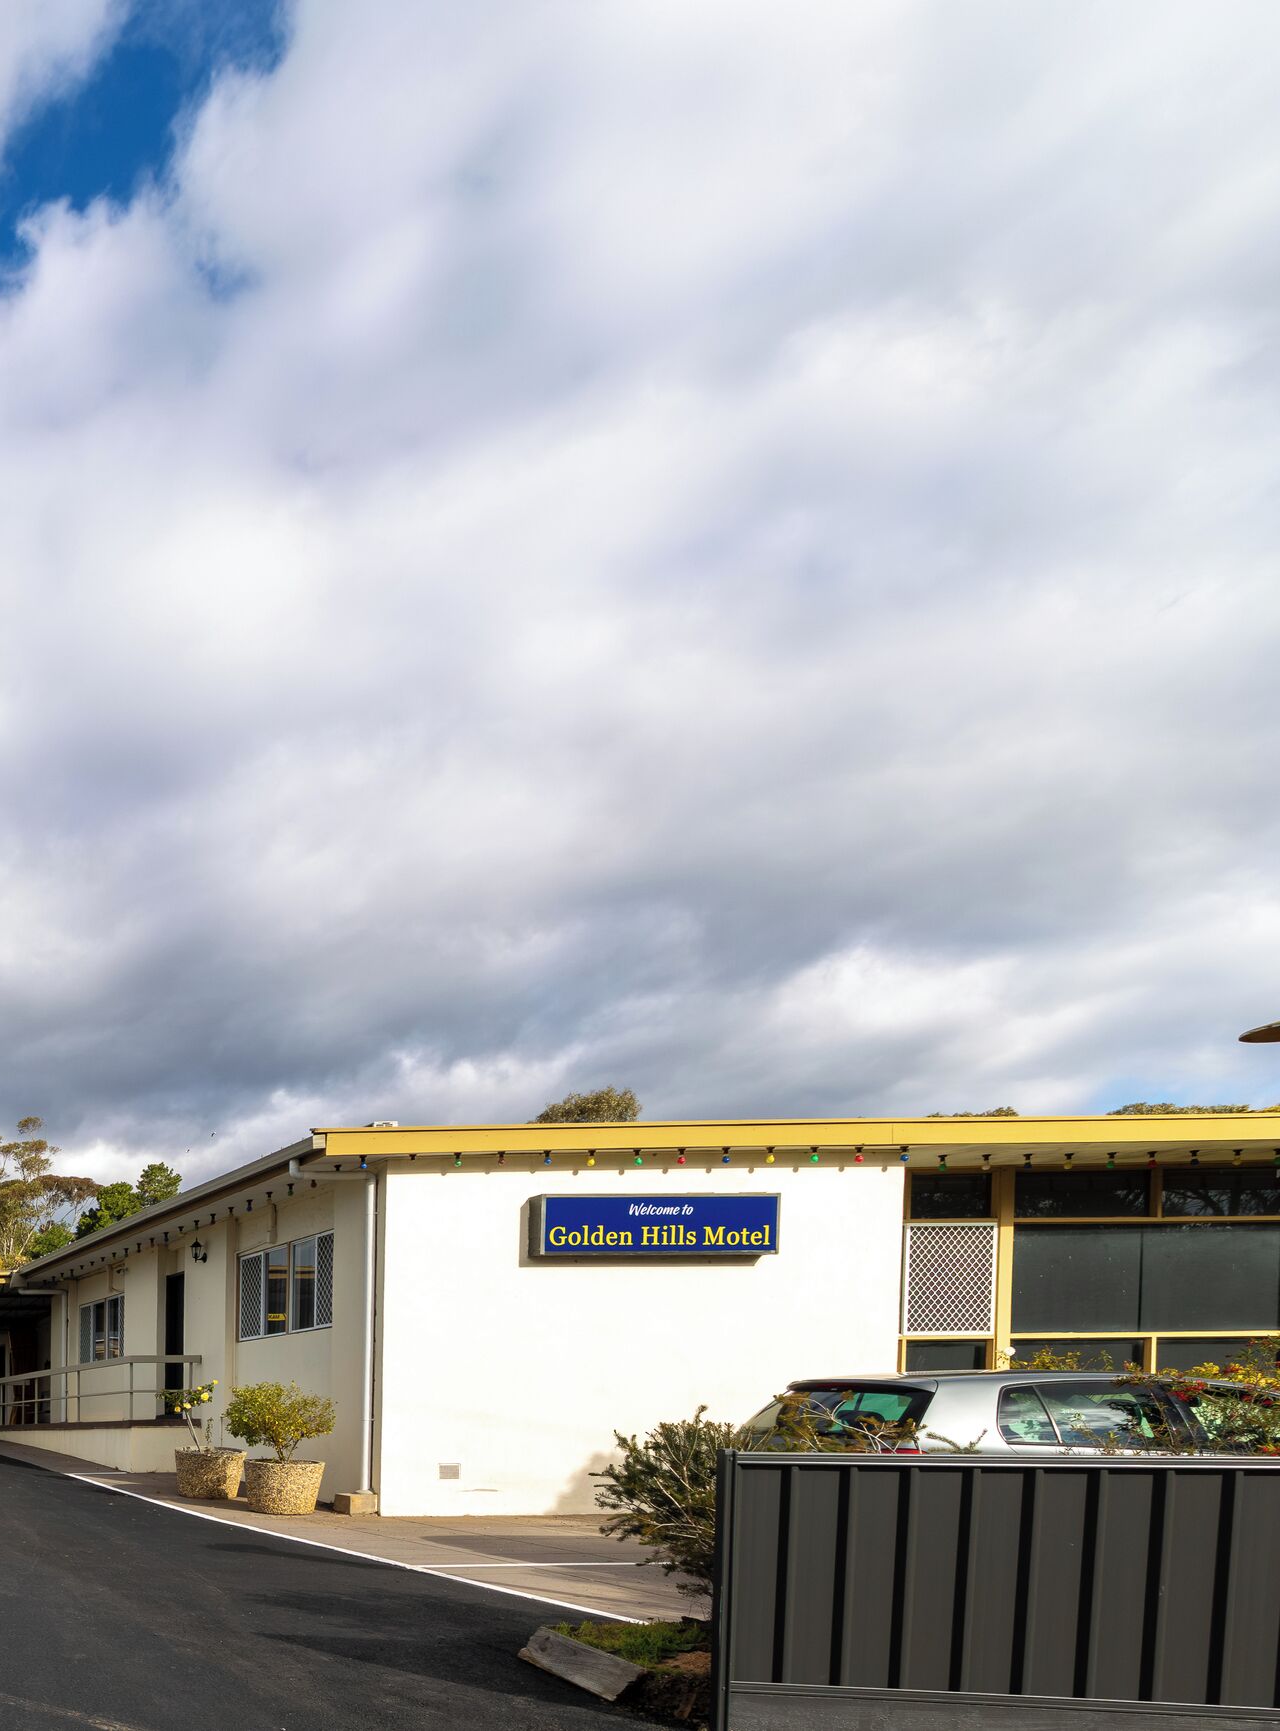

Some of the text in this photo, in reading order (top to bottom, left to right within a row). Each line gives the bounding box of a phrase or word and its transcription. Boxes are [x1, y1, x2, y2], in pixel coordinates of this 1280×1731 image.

[629, 1202, 694, 1217] Welcome to
[549, 1224, 771, 1246] Golden Hills Motel
